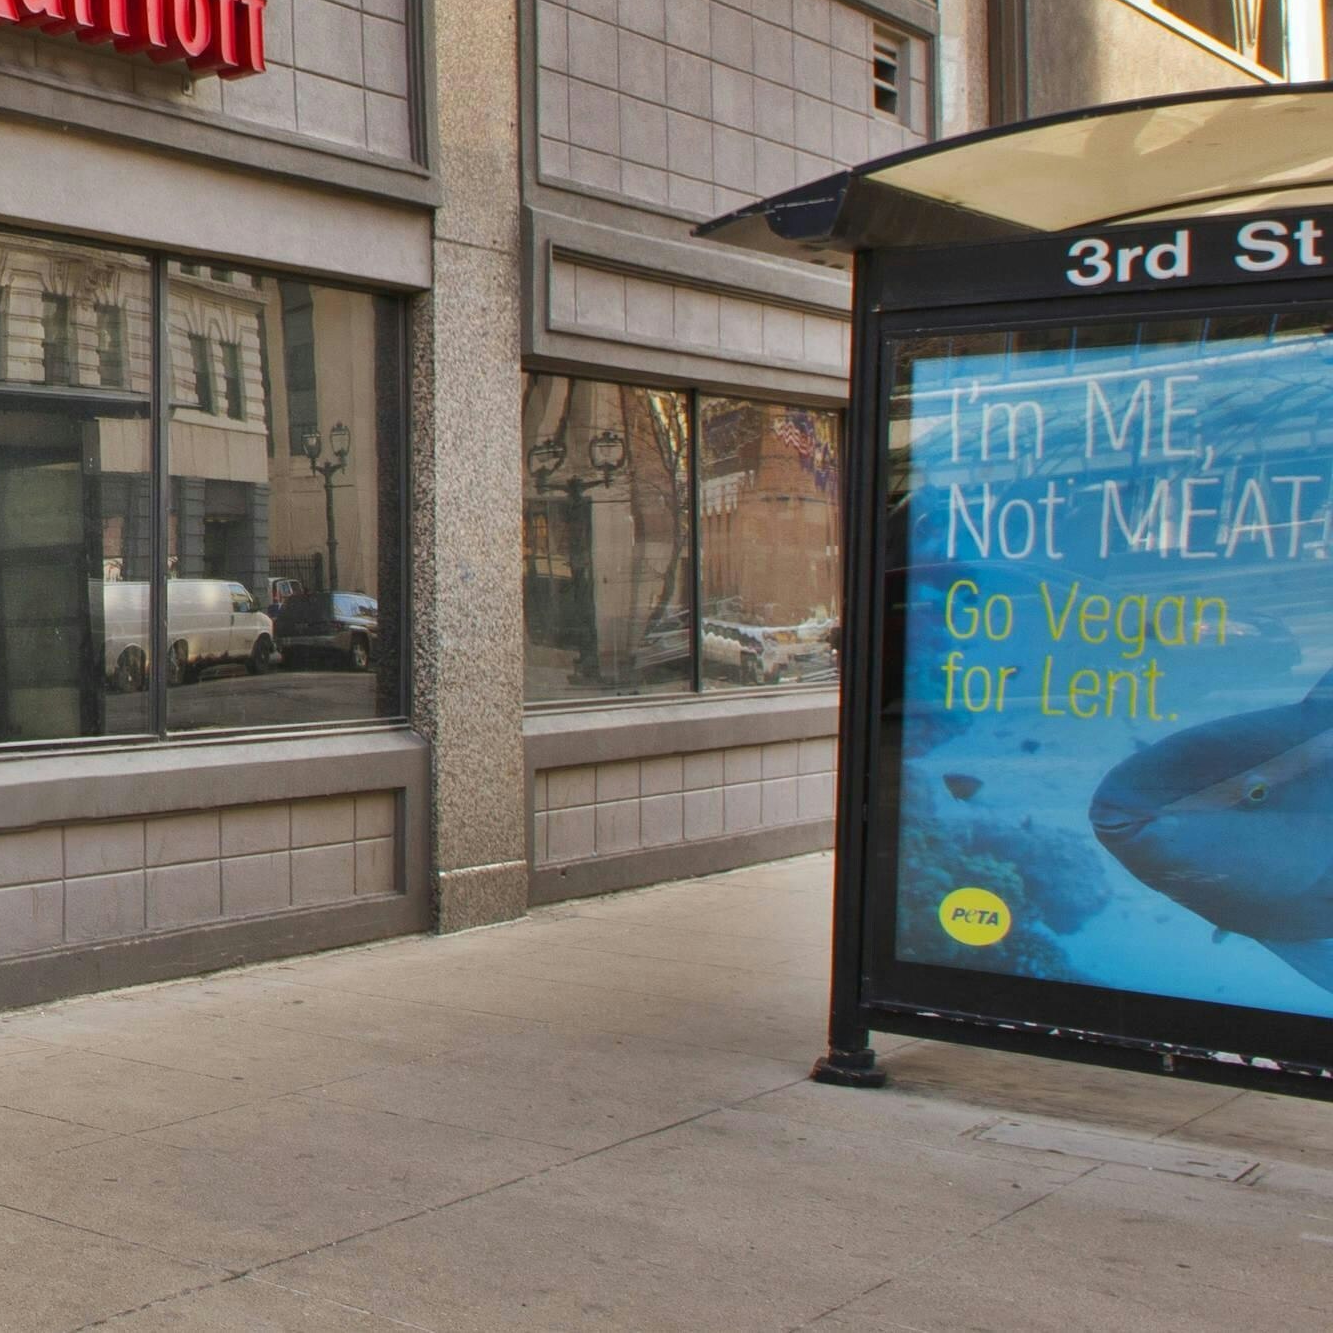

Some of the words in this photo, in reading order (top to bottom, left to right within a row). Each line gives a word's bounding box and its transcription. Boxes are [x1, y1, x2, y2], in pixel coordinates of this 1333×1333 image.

[1066, 230, 1190, 287] 3rd
[1235, 219, 1323, 273] St
[949, 379, 1045, 464] I'm
[1084, 375, 1215, 470] ME,
[947, 481, 1065, 560] Not
[945, 579, 1014, 641] Go
[1040, 580, 1228, 658] Vegan
[939, 652, 1018, 712] for
[1041, 656, 1179, 722] Lent.
